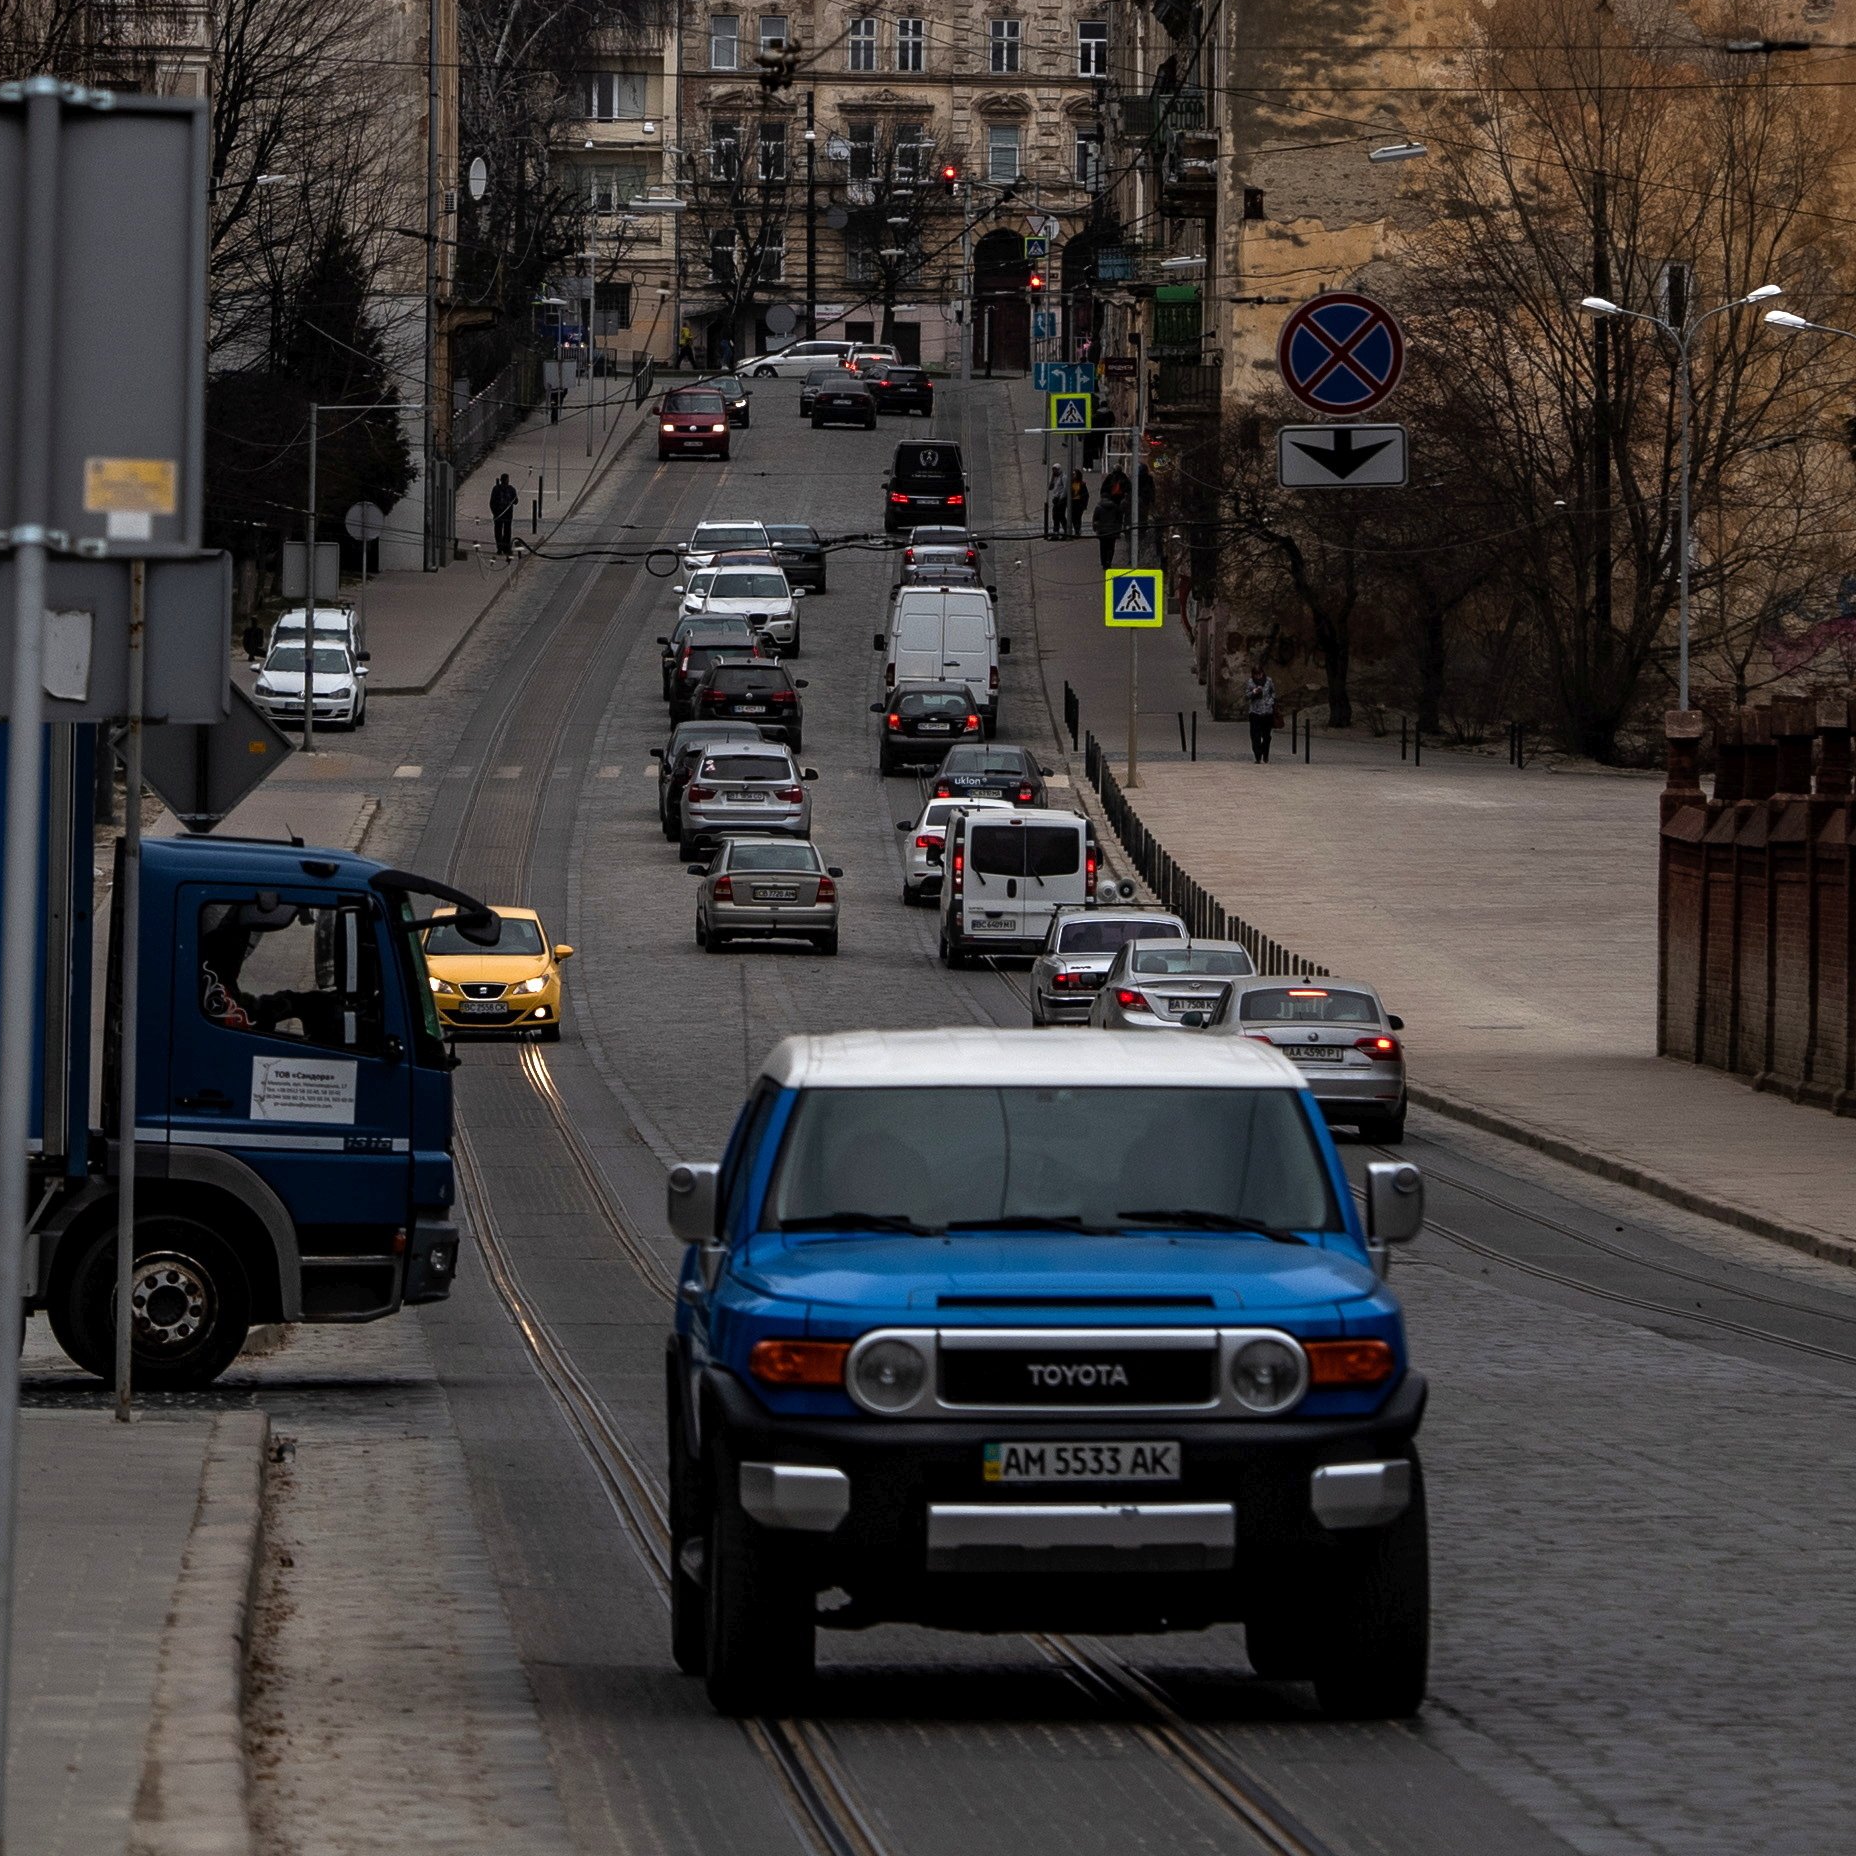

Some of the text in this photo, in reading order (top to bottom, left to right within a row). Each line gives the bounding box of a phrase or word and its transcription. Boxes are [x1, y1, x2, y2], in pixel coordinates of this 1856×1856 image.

[954, 776, 981, 785] uklon
[1304, 1047, 1326, 1058] 4590
[275, 1071, 291, 1079] ТОВ
[1025, 1362, 1130, 1387] TOYOTA
[1004, 1446, 1173, 1476] AM 5533 AK
